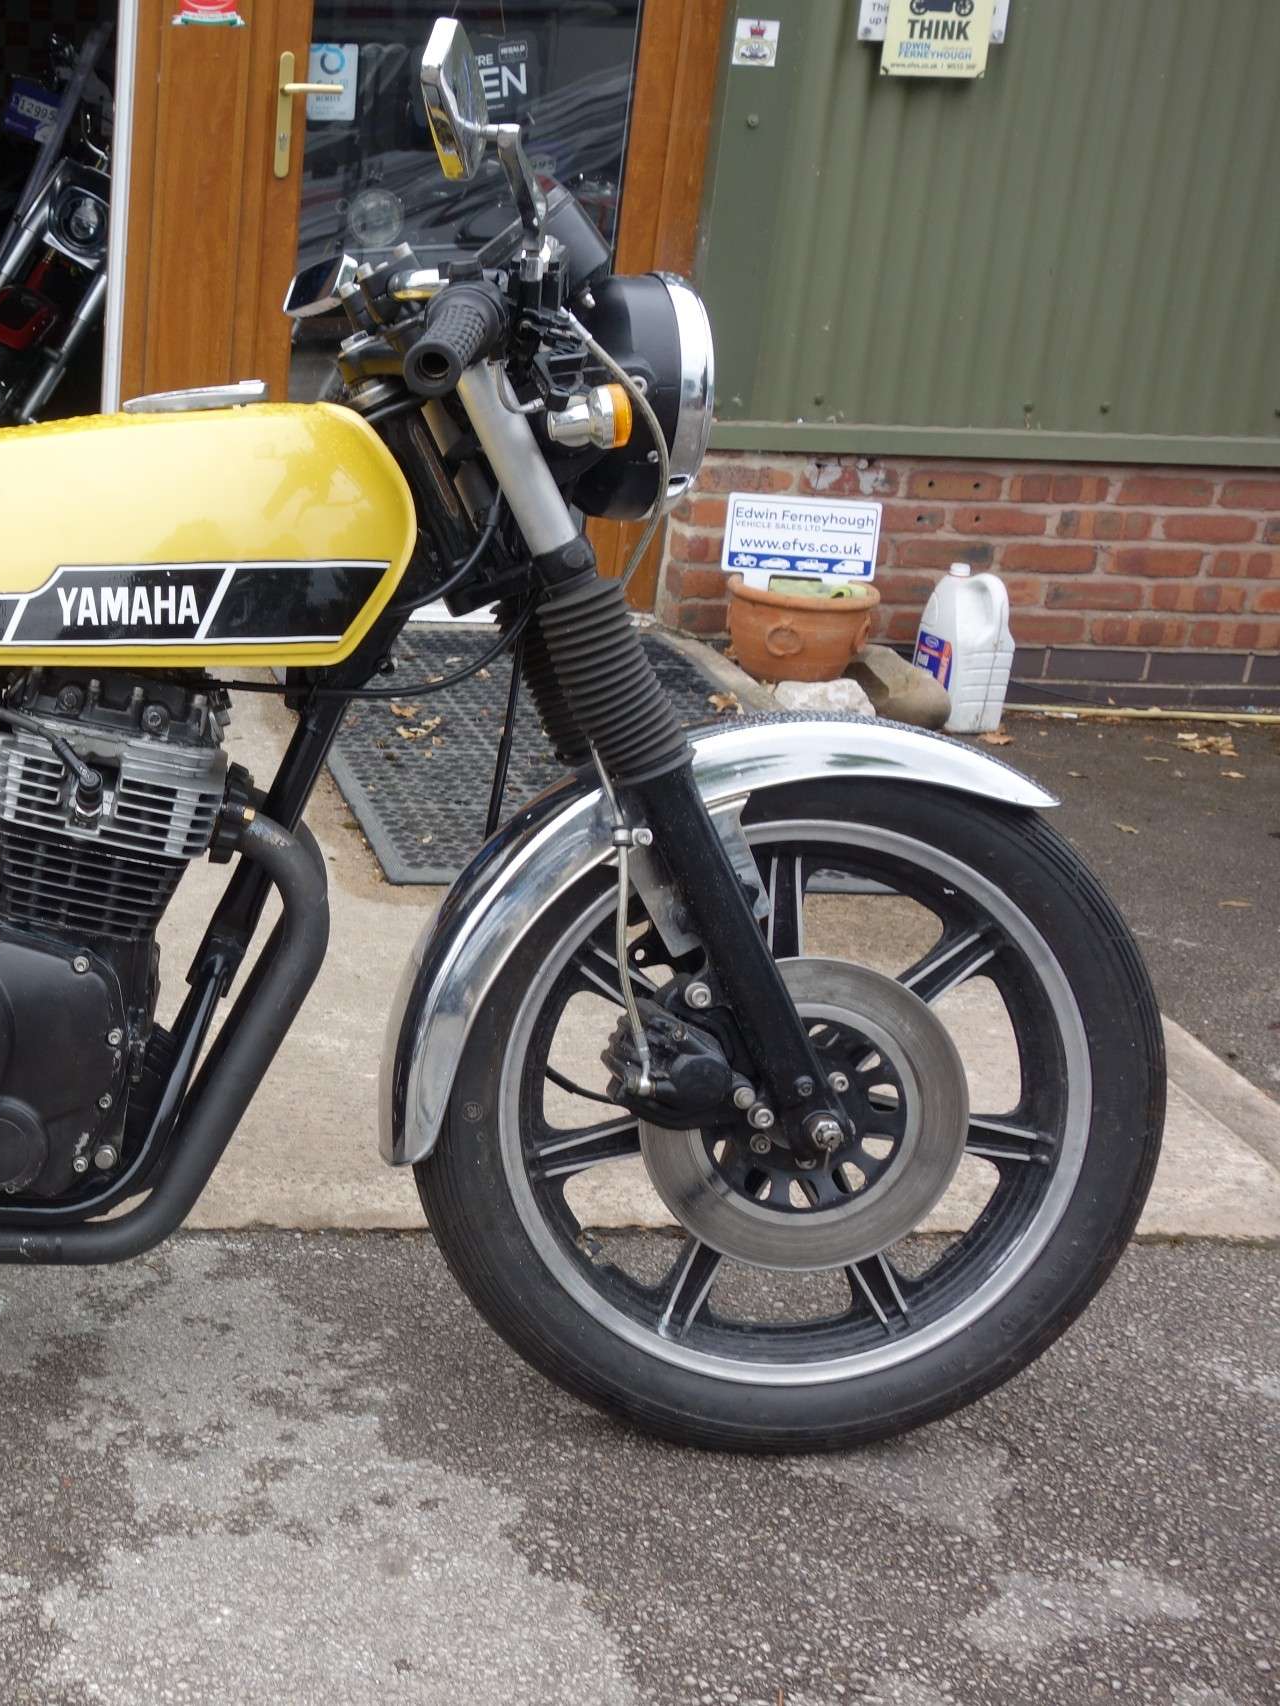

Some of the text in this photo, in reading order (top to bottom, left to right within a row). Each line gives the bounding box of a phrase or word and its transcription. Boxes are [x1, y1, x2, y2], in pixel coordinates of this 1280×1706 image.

[908, 19, 971, 40] THINK
[898, 49, 972, 60] FERNEYHOUGH
[899, 41, 931, 50] EDWIN
[478, 62, 527, 99] EN
[735, 506, 875, 529] Edwin Ferneyhough
[735, 520, 820, 532] VEHICLE SALES LTD
[740, 537, 863, 555] www.efvs.co.uk
[57, 585, 200, 626] YAMAHA
